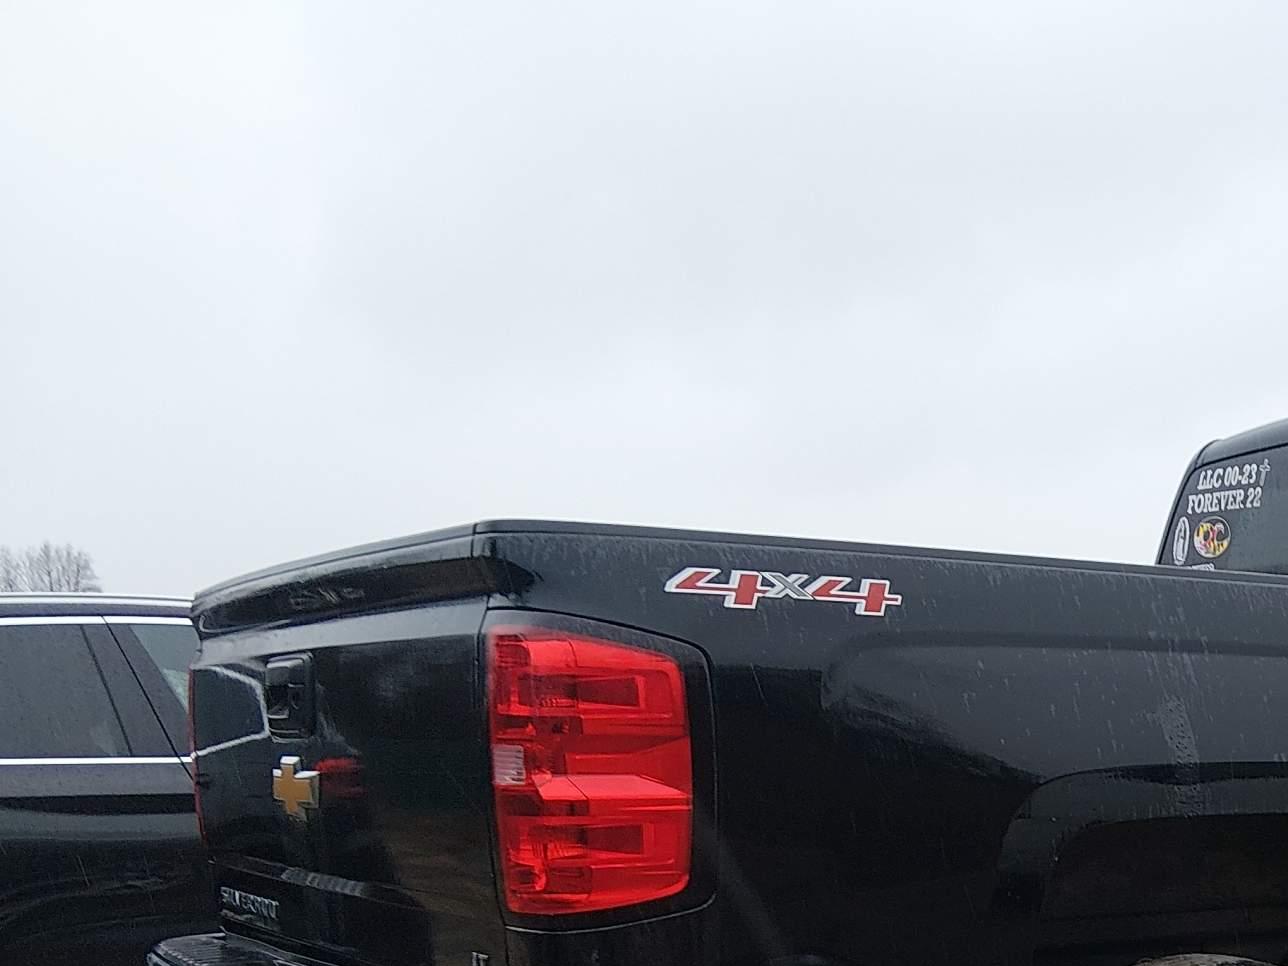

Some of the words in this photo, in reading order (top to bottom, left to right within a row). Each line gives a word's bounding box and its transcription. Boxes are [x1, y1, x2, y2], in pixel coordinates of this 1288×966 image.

[1197, 468, 1224, 490] LLC
[1187, 488, 1245, 515] FOREVER
[1245, 486, 1263, 508] 22
